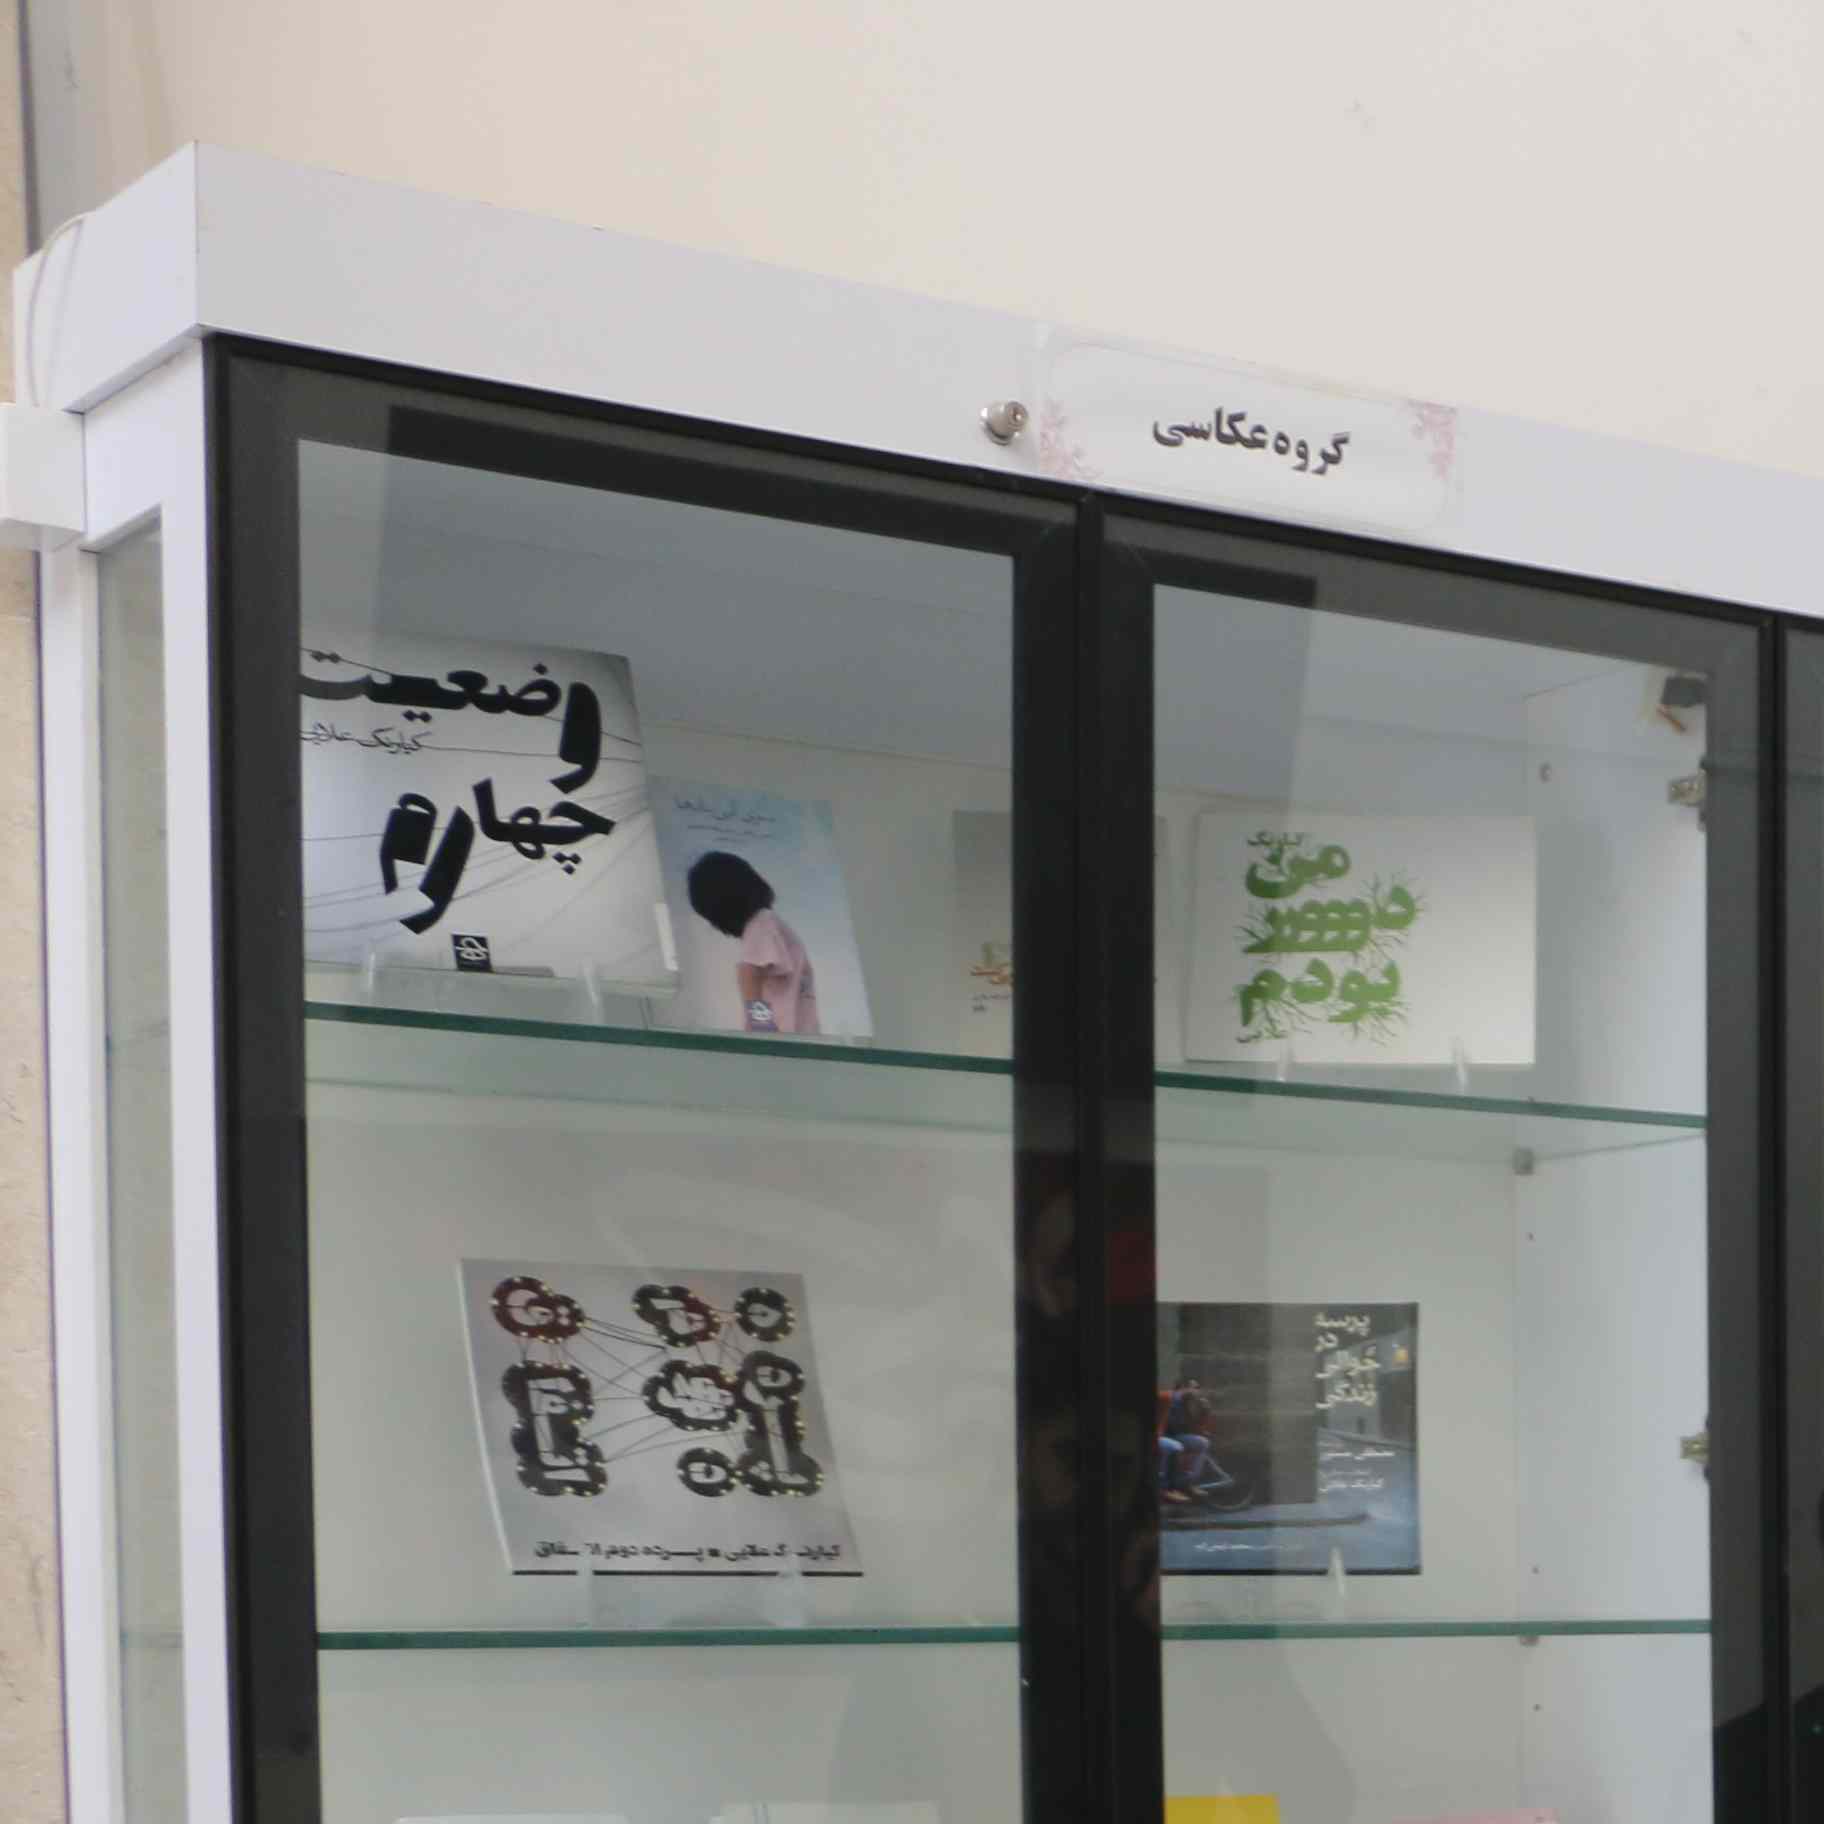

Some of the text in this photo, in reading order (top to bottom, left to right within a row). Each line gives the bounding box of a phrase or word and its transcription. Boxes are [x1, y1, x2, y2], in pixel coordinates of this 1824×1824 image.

[1152, 406, 1350, 475] گروه عکاسی
[300, 653, 602, 794] وضعیت
[380, 777, 617, 935] چهارم
